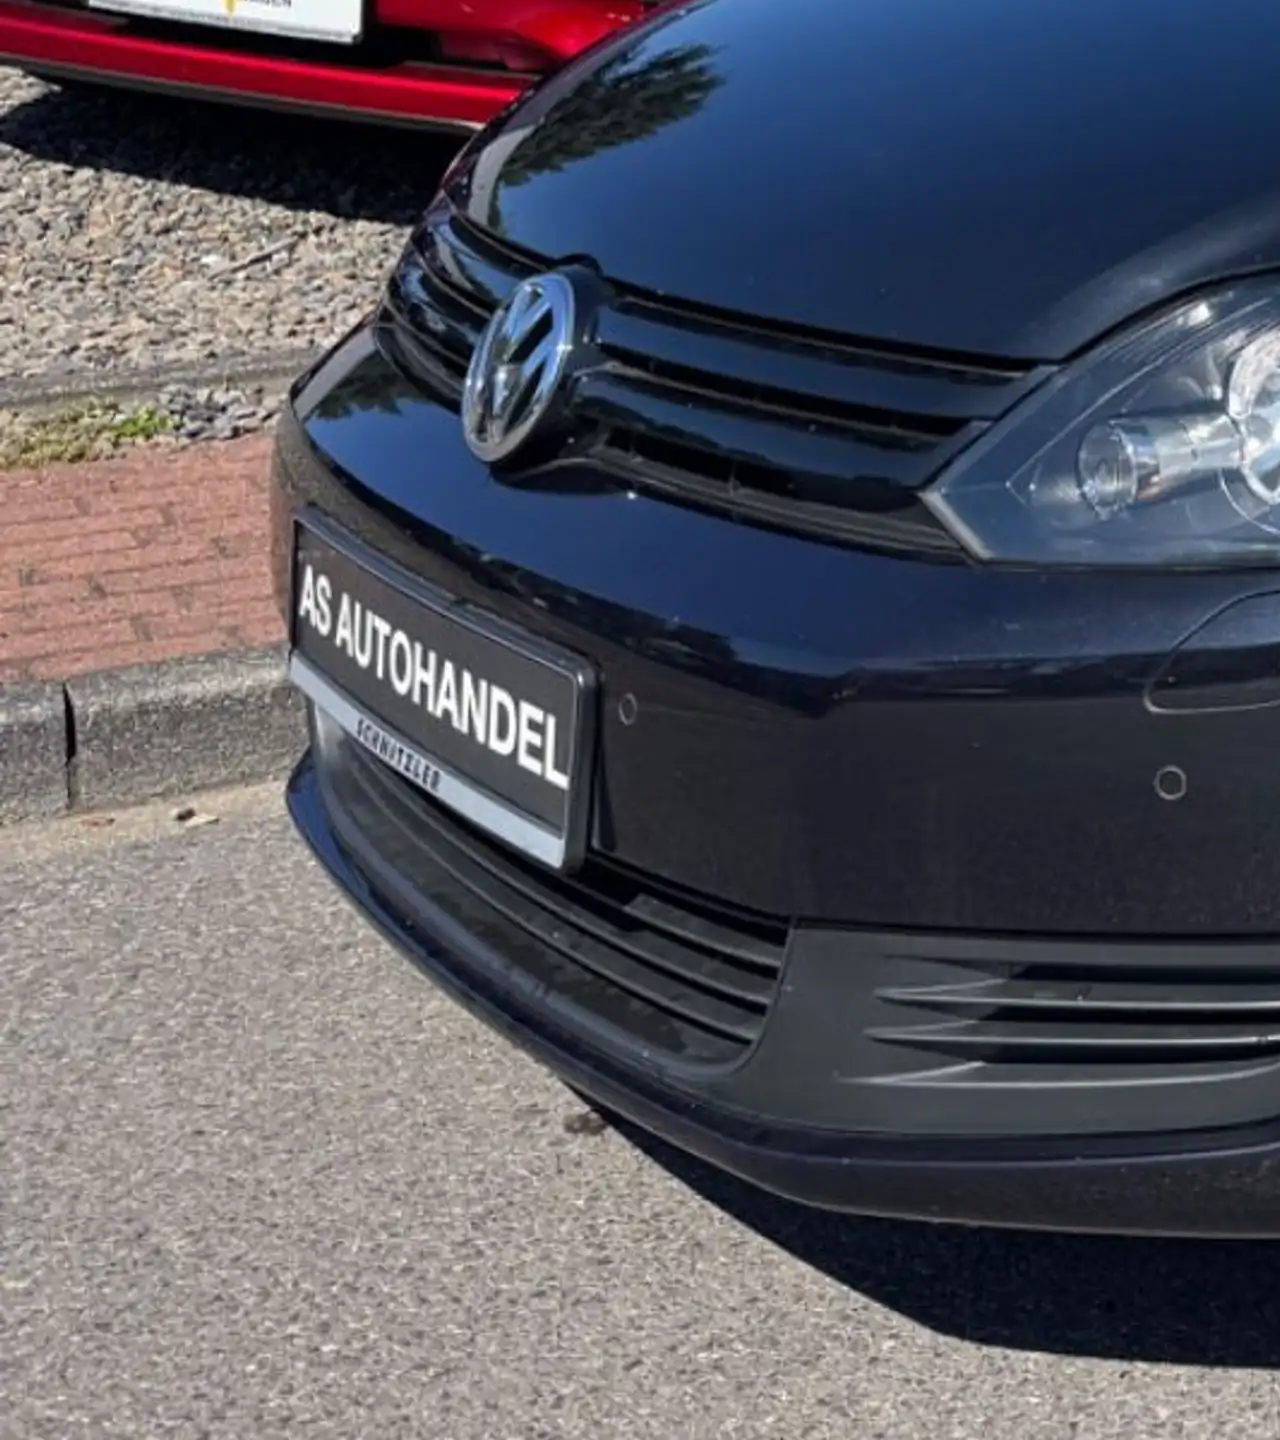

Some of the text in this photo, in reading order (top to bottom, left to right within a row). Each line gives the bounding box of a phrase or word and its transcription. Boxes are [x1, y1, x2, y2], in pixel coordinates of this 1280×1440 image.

[300, 565, 570, 791] AS AUTOHANDEL
[357, 716, 440, 792] SCHNITZLER
